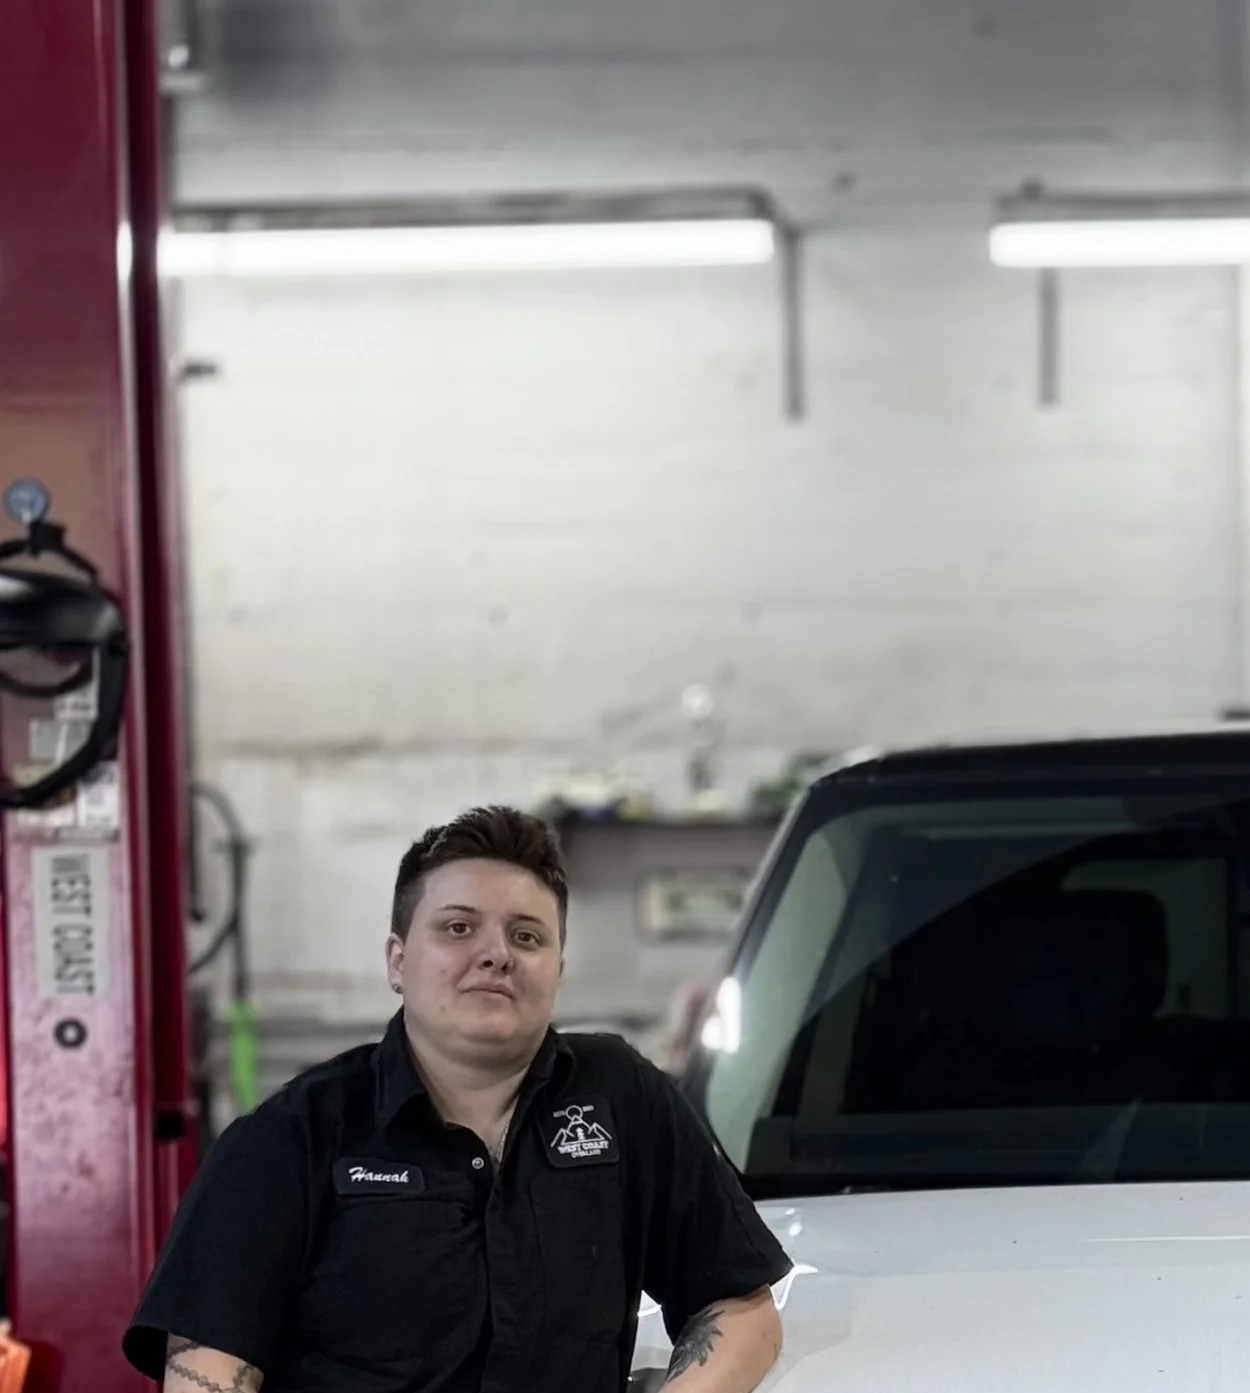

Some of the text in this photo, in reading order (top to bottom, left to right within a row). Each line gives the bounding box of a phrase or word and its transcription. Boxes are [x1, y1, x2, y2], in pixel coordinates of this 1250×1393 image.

[51, 855, 95, 996] WEST COAST
[348, 1166, 409, 1183] Hannah
